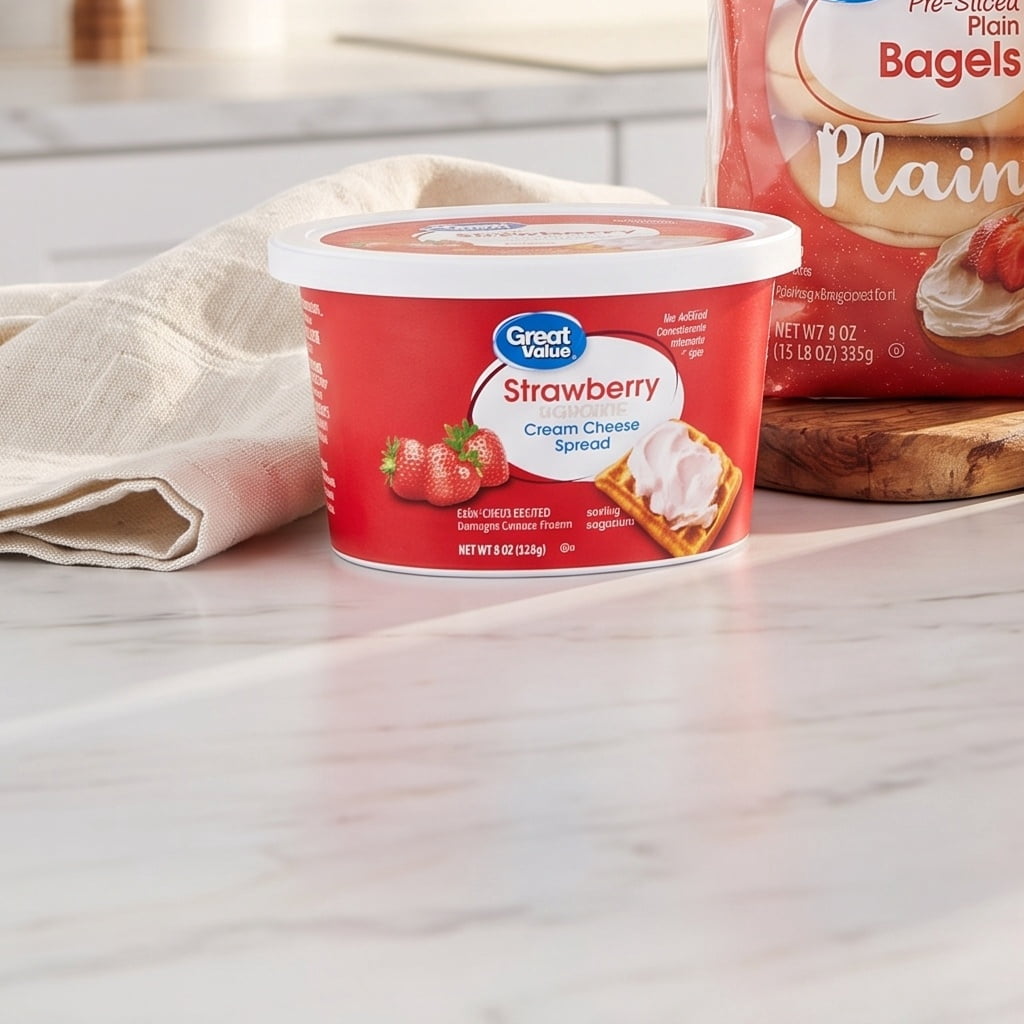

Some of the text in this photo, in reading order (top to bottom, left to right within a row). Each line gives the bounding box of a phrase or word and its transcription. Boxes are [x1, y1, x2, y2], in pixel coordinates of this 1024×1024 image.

[968, 15, 1020, 36] Plain
[880, 41, 1022, 88] Bagels
[506, 325, 572, 346] Great
[775, 322, 800, 339] NET
[521, 344, 572, 359] Value
[503, 377, 661, 403] Strawberry
[524, 419, 640, 436] Cream Cheese
[554, 436, 611, 454] Spread
[458, 543, 476, 556] NET
[477, 543, 492, 556] WT
